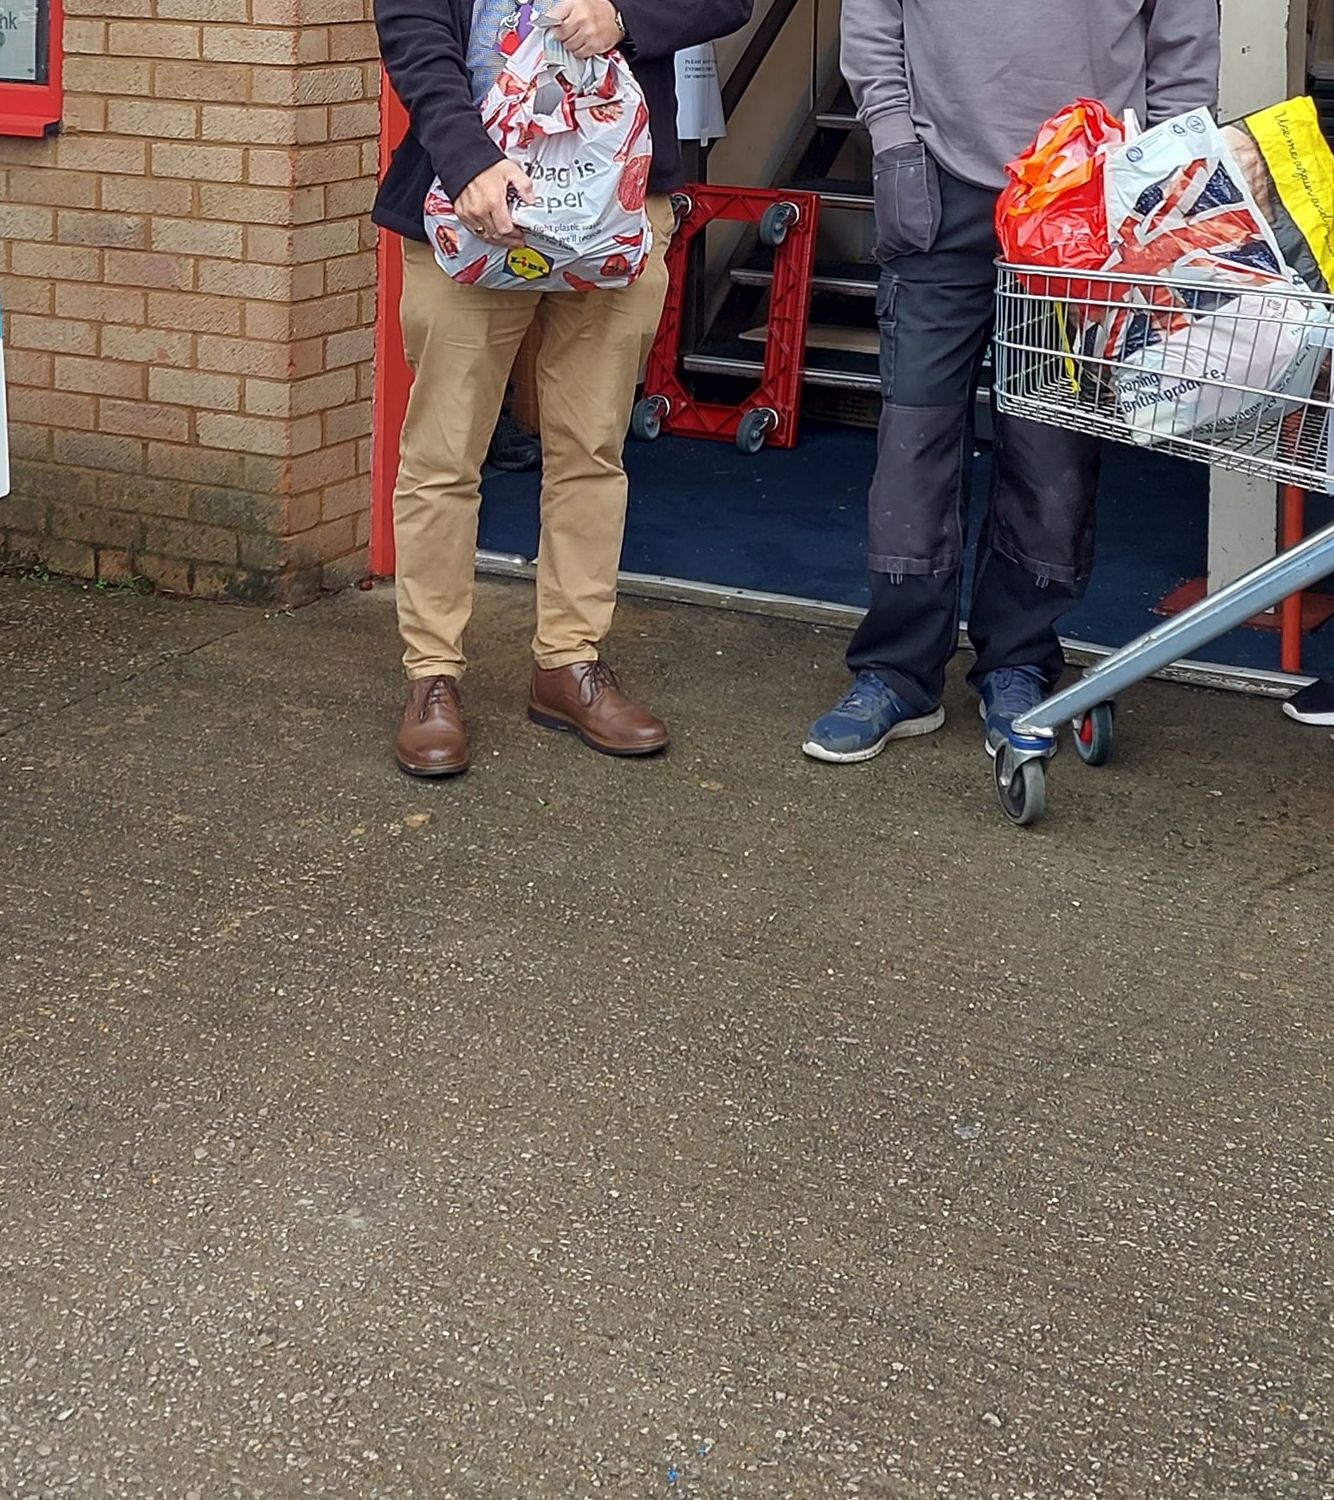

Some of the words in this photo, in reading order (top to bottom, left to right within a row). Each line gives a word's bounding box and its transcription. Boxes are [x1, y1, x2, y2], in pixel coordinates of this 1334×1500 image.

[1274, 110, 1291, 138] Use
[534, 162, 571, 188] bag
[574, 159, 596, 178] is
[1122, 387, 1166, 414] British
